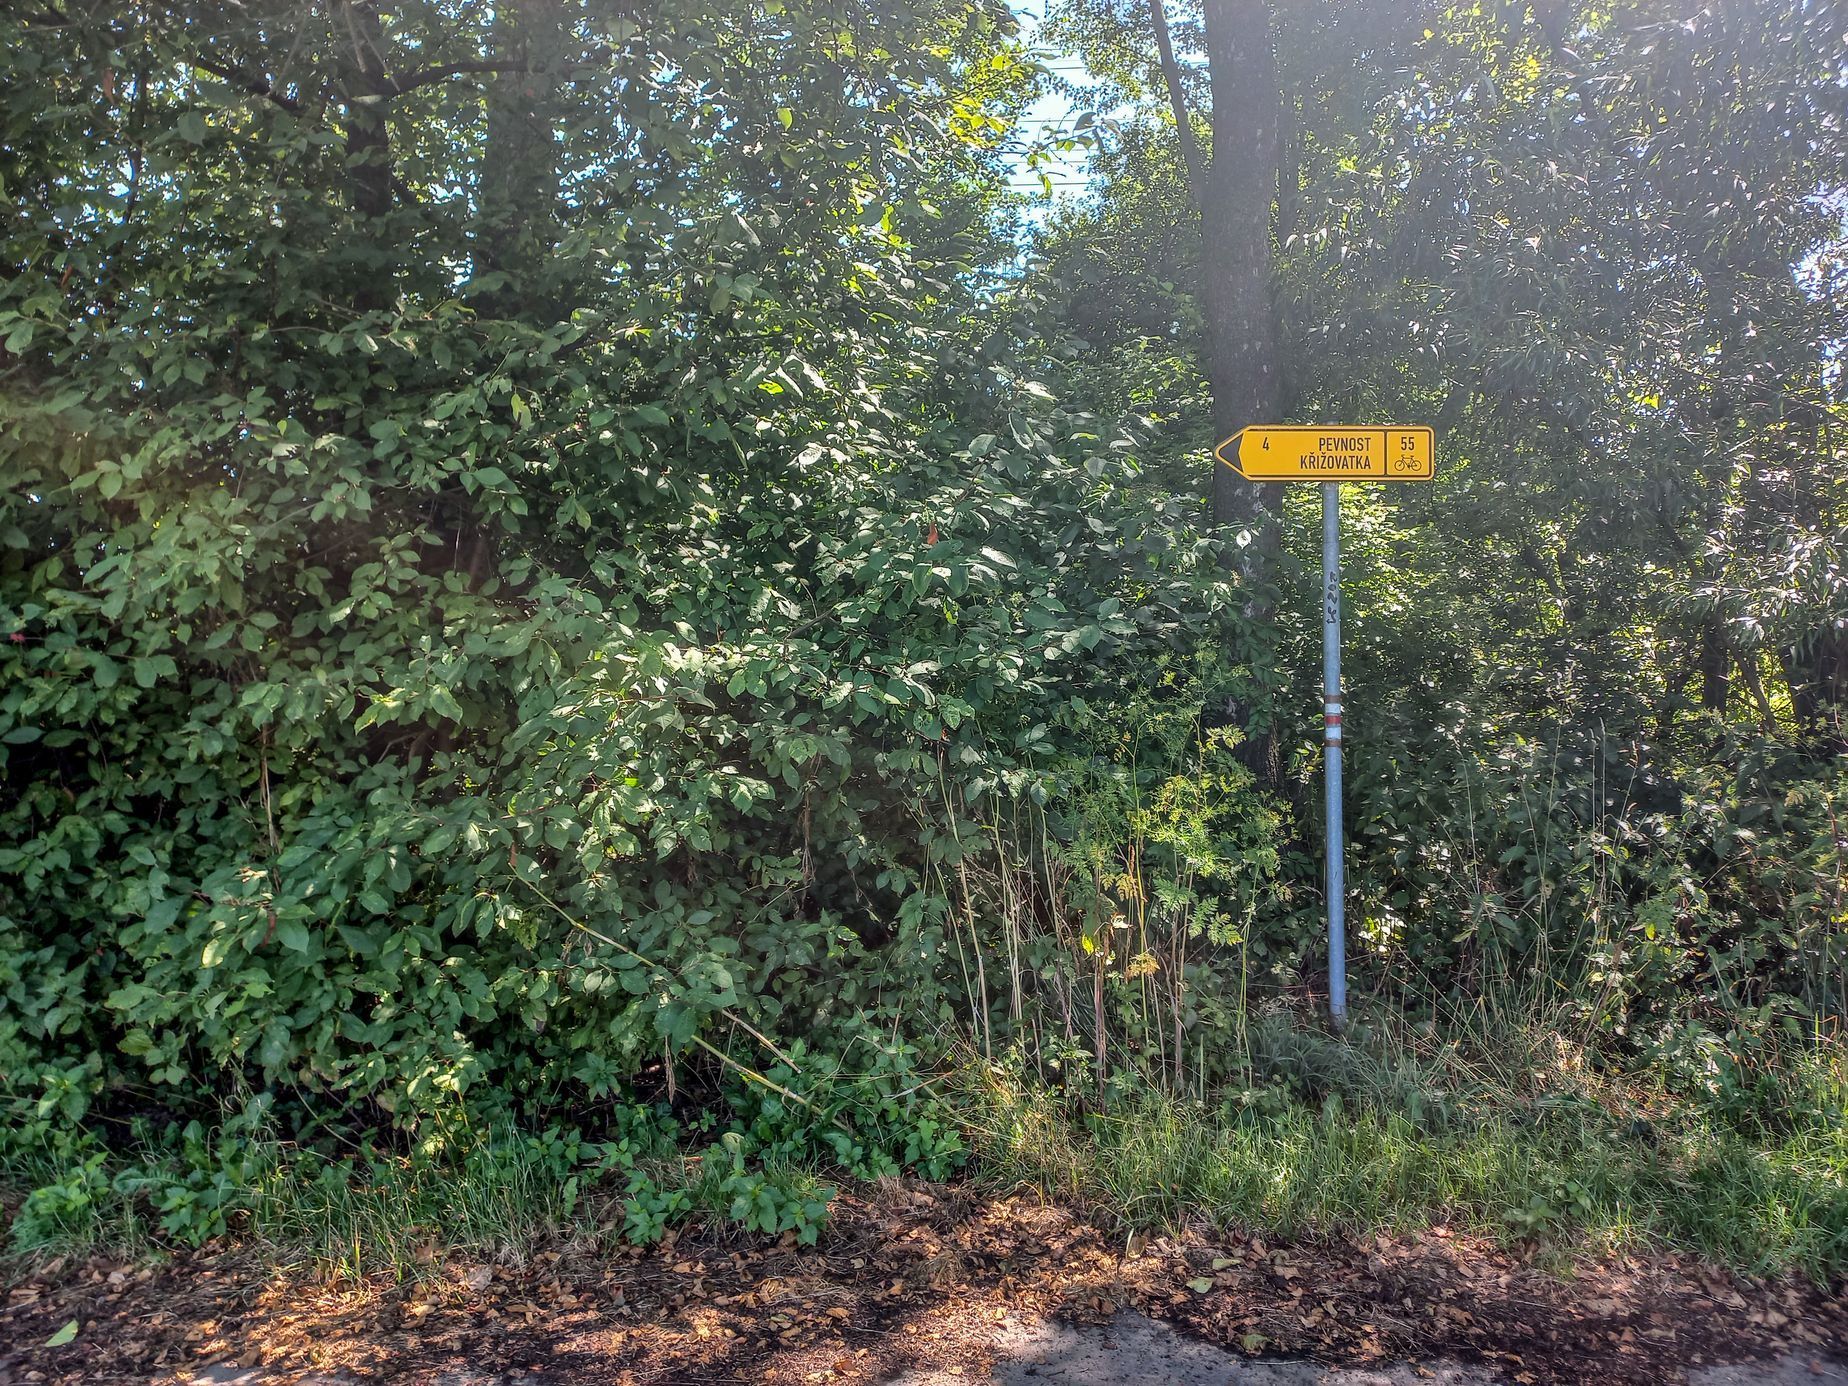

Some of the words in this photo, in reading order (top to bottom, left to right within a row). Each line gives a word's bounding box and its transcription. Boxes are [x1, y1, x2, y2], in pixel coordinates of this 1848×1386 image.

[1262, 437, 1270, 451] 4
[1318, 437, 1372, 451] PEVNOST
[1400, 437, 1415, 451] 55
[1300, 452, 1371, 470] KŘIŽOVATKA
